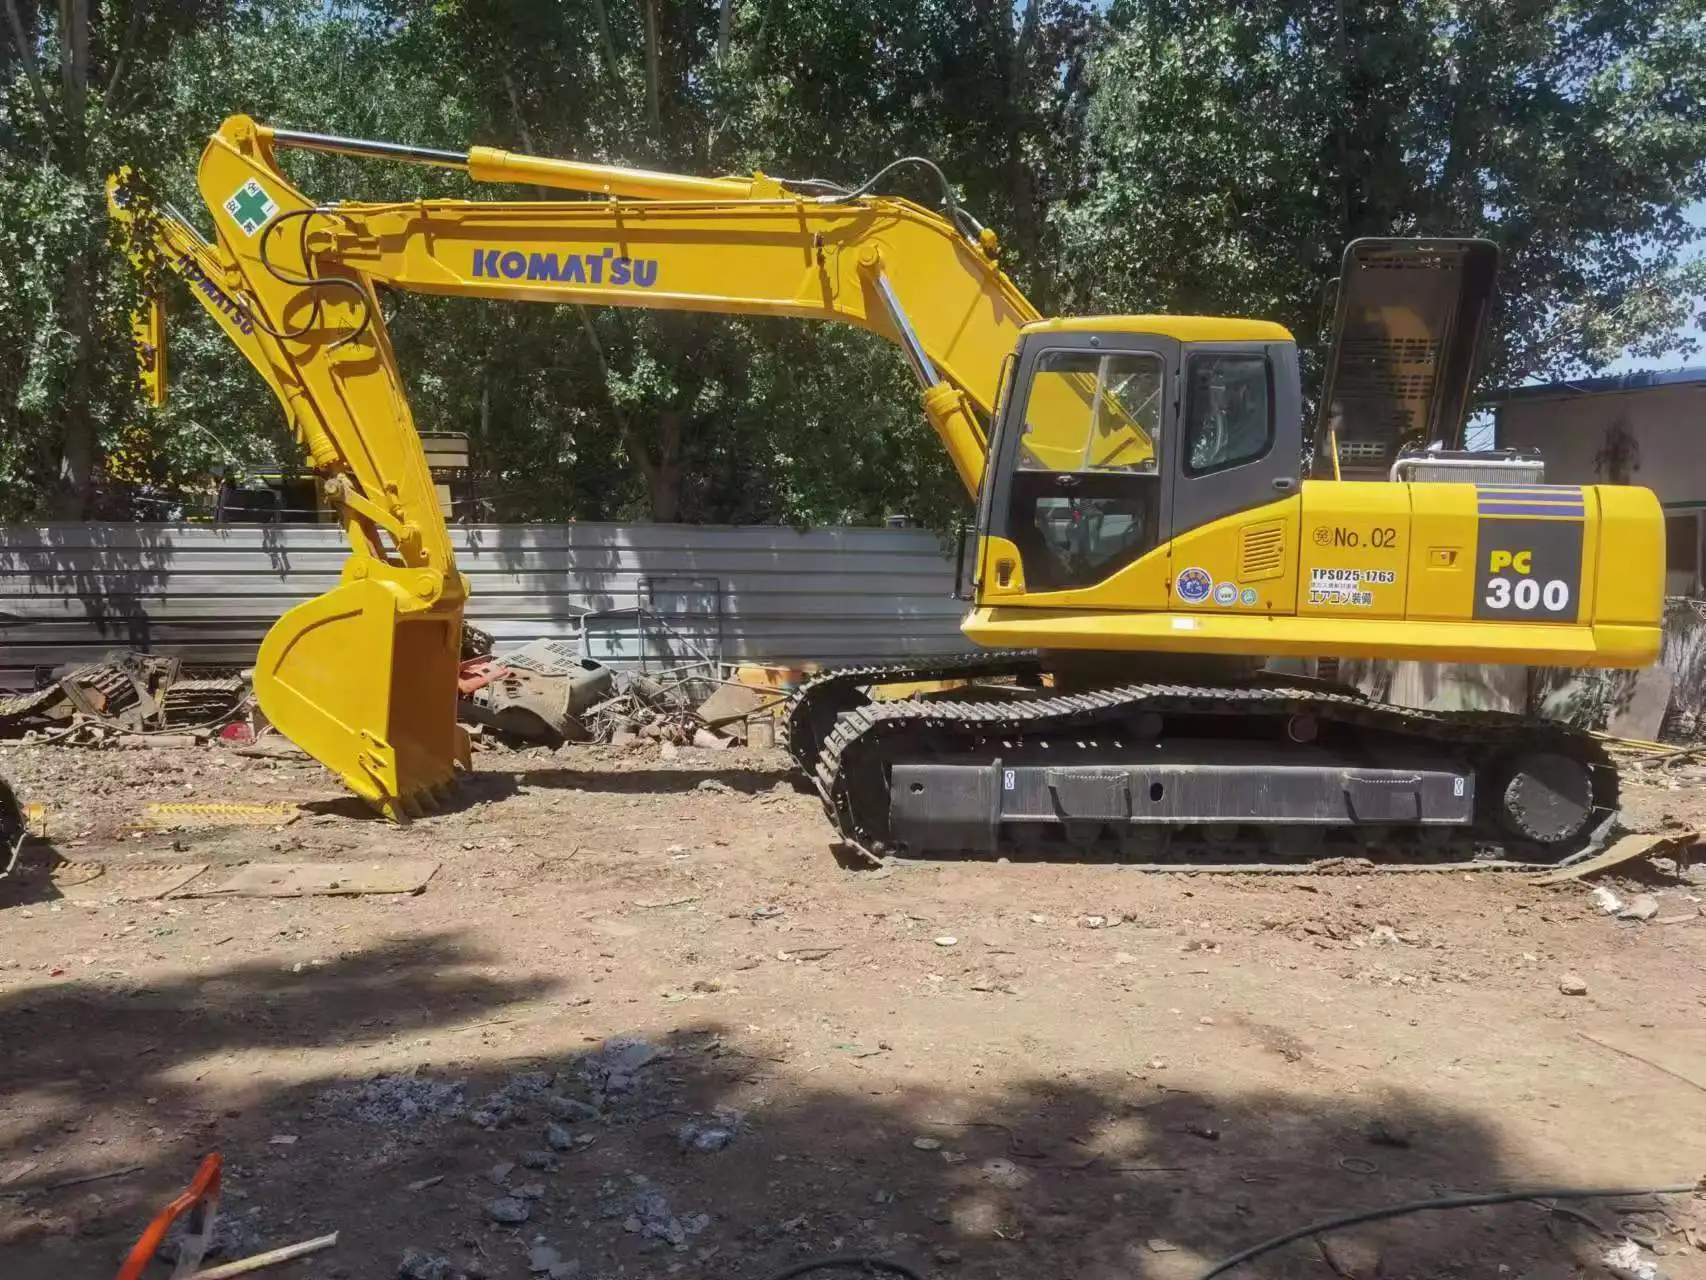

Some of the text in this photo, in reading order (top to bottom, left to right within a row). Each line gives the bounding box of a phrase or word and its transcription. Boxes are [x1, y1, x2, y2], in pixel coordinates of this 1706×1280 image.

[472, 247, 658, 287] KOMATSU
[178, 254, 254, 335] KOMATSU
[1312, 568, 1394, 583] TPS025-1763
[1490, 550, 1532, 574] PC
[1485, 578, 1569, 611] 300
